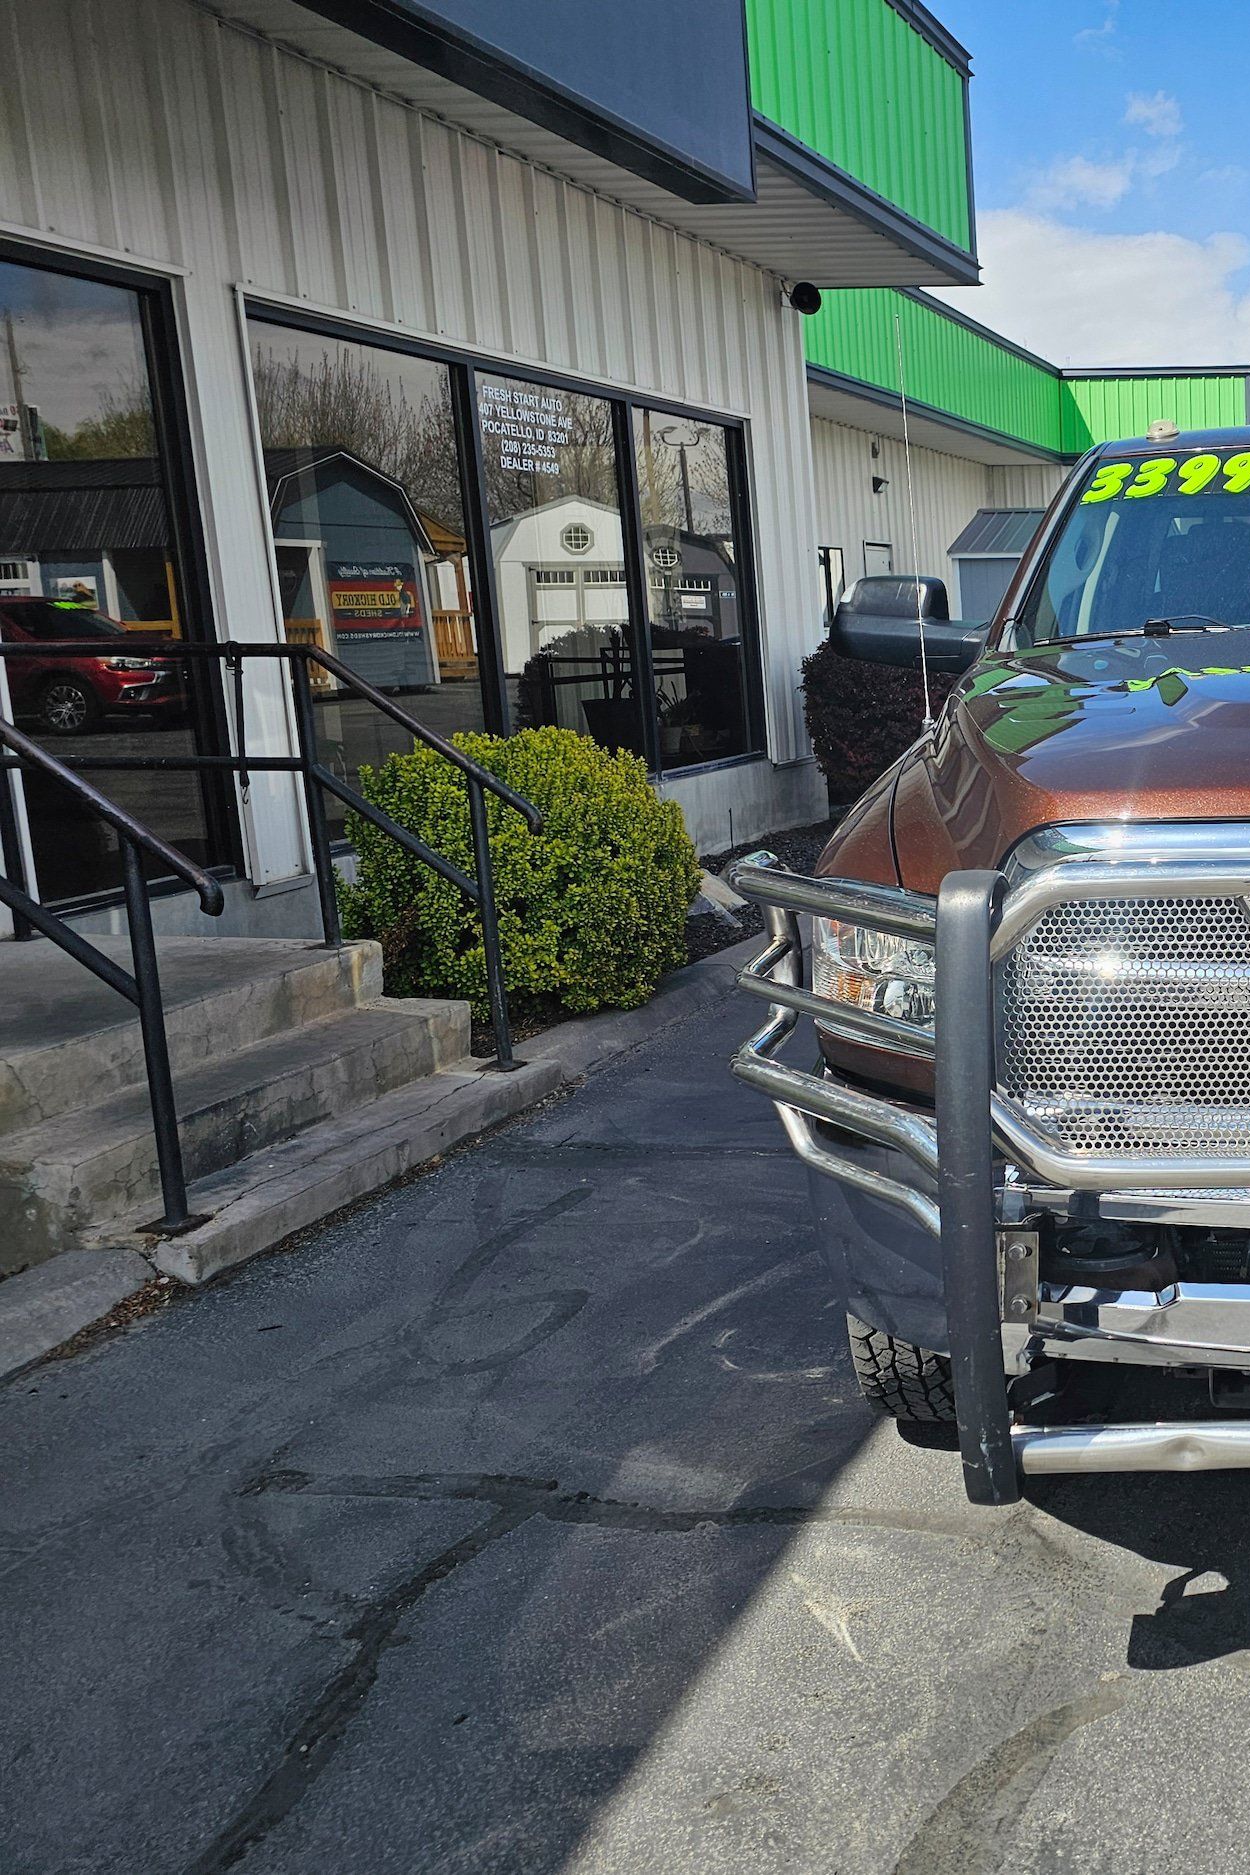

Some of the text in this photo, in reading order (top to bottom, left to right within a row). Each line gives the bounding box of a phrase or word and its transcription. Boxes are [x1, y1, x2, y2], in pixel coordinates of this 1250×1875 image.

[483, 385, 562, 412] FRESH START AUTO
[480, 402, 573, 429] 407 YELLOWSTONE AVE
[482, 419, 568, 444] POCATELLO, ID 83201
[501, 440, 556, 458] (208) 235-5353
[500, 456, 534, 472] DEALER
[541, 462, 560, 475] 4549
